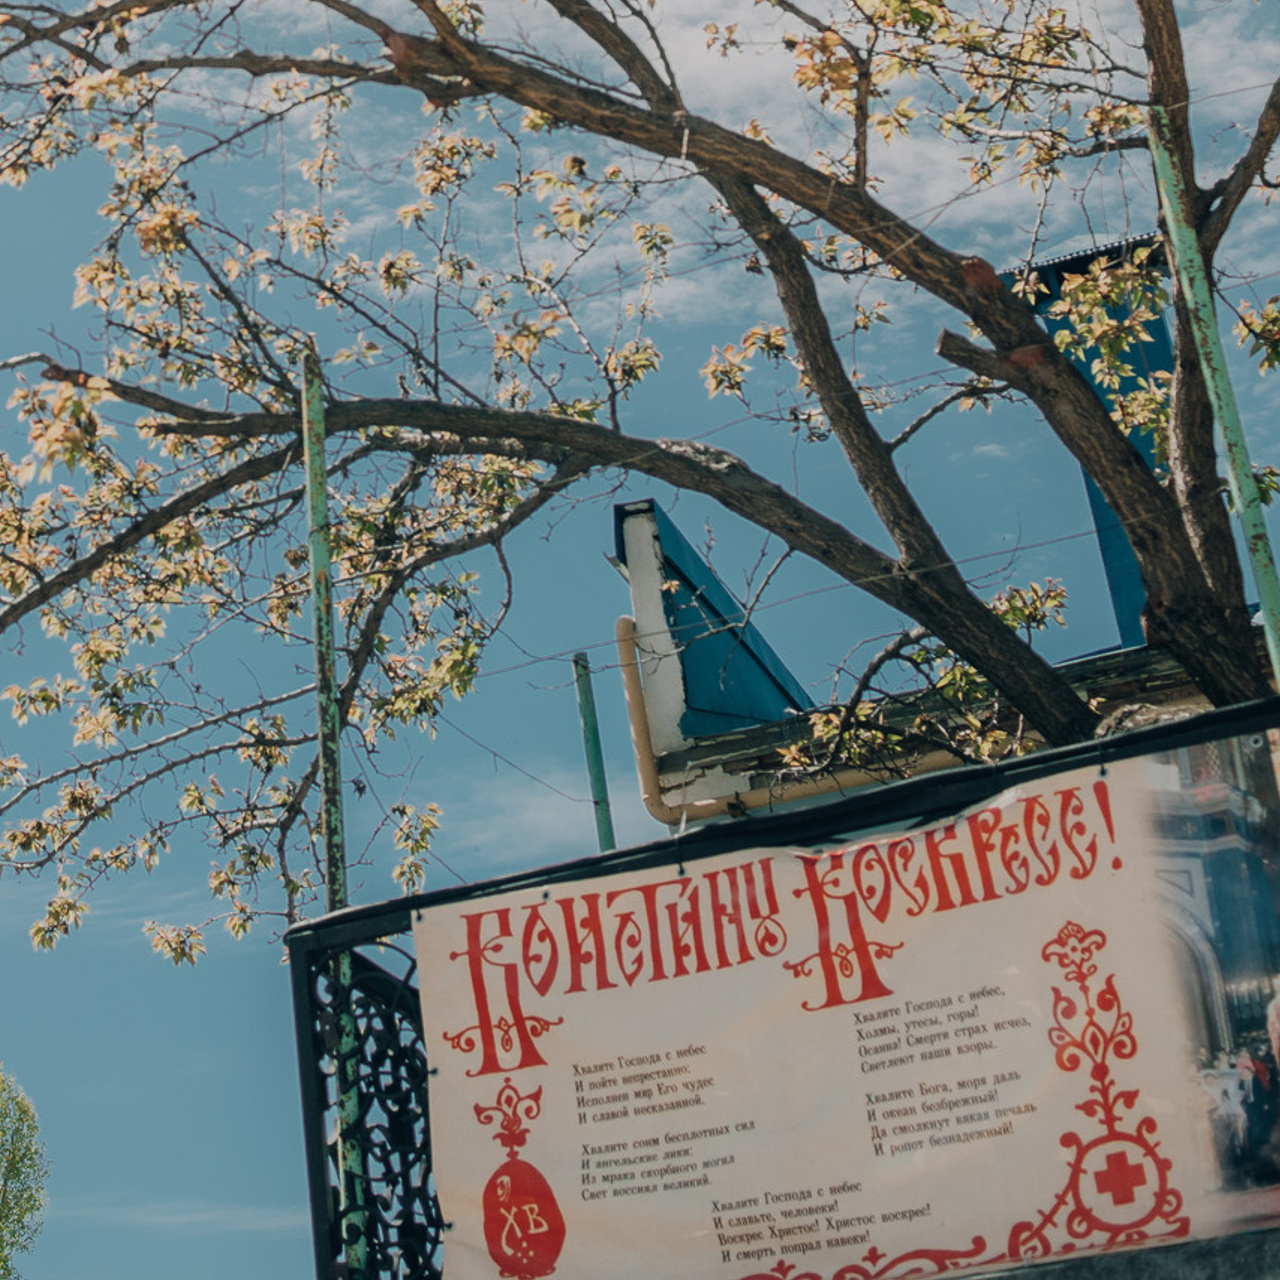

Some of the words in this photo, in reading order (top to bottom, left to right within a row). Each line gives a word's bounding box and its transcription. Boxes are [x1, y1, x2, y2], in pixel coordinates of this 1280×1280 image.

[853, 1009, 900, 1025] Хвалите
[905, 997, 953, 1014] Господа
[959, 995, 964, 1003] с
[970, 986, 1005, 1000] небес,
[856, 1026, 899, 1041] Холмы,
[947, 1005, 979, 1022] горы!
[859, 1038, 901, 1058] Осанна!
[907, 1032, 949, 1047] Смерти
[955, 1024, 988, 1037] страх
[994, 1018, 1031, 1030] исчез,
[573, 1063, 614, 1076] Хвалите
[618, 1053, 661, 1068] Господа
[666, 1052, 671, 1061] с
[677, 1045, 706, 1058] небес
[861, 1054, 914, 1073] Светлеют
[921, 1047, 951, 1061] наши
[957, 1041, 997, 1056] взоры.
[575, 1081, 583, 1093] И
[589, 1077, 617, 1088] пойте
[577, 1092, 629, 1108] Исполнен
[634, 1089, 653, 1100] мир
[657, 1083, 677, 1094] Его
[683, 1077, 713, 1092] чудес
[866, 1089, 914, 1105] Хвалите
[919, 1082, 952, 1096] Бога,
[957, 1076, 986, 1089] моря
[993, 1071, 1020, 1085] даль
[578, 1113, 587, 1124] И
[592, 1106, 629, 1122] славой
[634, 1094, 705, 1115] несказанной.
[868, 1110, 876, 1121] И
[883, 1107, 916, 1119] океан
[922, 1090, 998, 1112] безбрежный!
[582, 1140, 628, 1155] Хвалите
[665, 1125, 730, 1144] бесплотных
[735, 1121, 755, 1131] сил
[871, 1124, 887, 1141] Да
[892, 1118, 949, 1136] смолкнут
[995, 1103, 1036, 1118] печаль
[874, 1144, 883, 1156] И
[890, 1140, 923, 1156] ропот
[930, 1122, 1013, 1148] безнадежный!
[581, 1159, 590, 1170] И
[596, 1152, 657, 1169] ангельские
[581, 1174, 596, 1185] Из
[602, 1170, 635, 1183] мрака
[641, 1161, 697, 1178] скорбного
[703, 1155, 734, 1168] могил
[581, 1189, 607, 1201] Свет
[613, 1183, 658, 1197] воссиял
[663, 1175, 712, 1191] великий.
[712, 1198, 759, 1213] Хвалите
[764, 1189, 812, 1205] Господа
[818, 1189, 823, 1197] с
[830, 1181, 862, 1194] небес
[500, 1204, 549, 1256] ХВ
[713, 1218, 721, 1229] И
[728, 1214, 776, 1227] славьте,
[781, 1200, 838, 1219] человеки!
[718, 1231, 764, 1246] Воскрес
[770, 1220, 819, 1239] Христос!
[826, 1214, 875, 1231] Христос
[882, 1203, 931, 1222] воскрес!
[722, 1250, 731, 1263] И
[737, 1247, 776, 1259] смерть
[781, 1240, 821, 1254] попрал
[827, 1231, 870, 1248] навеки!
